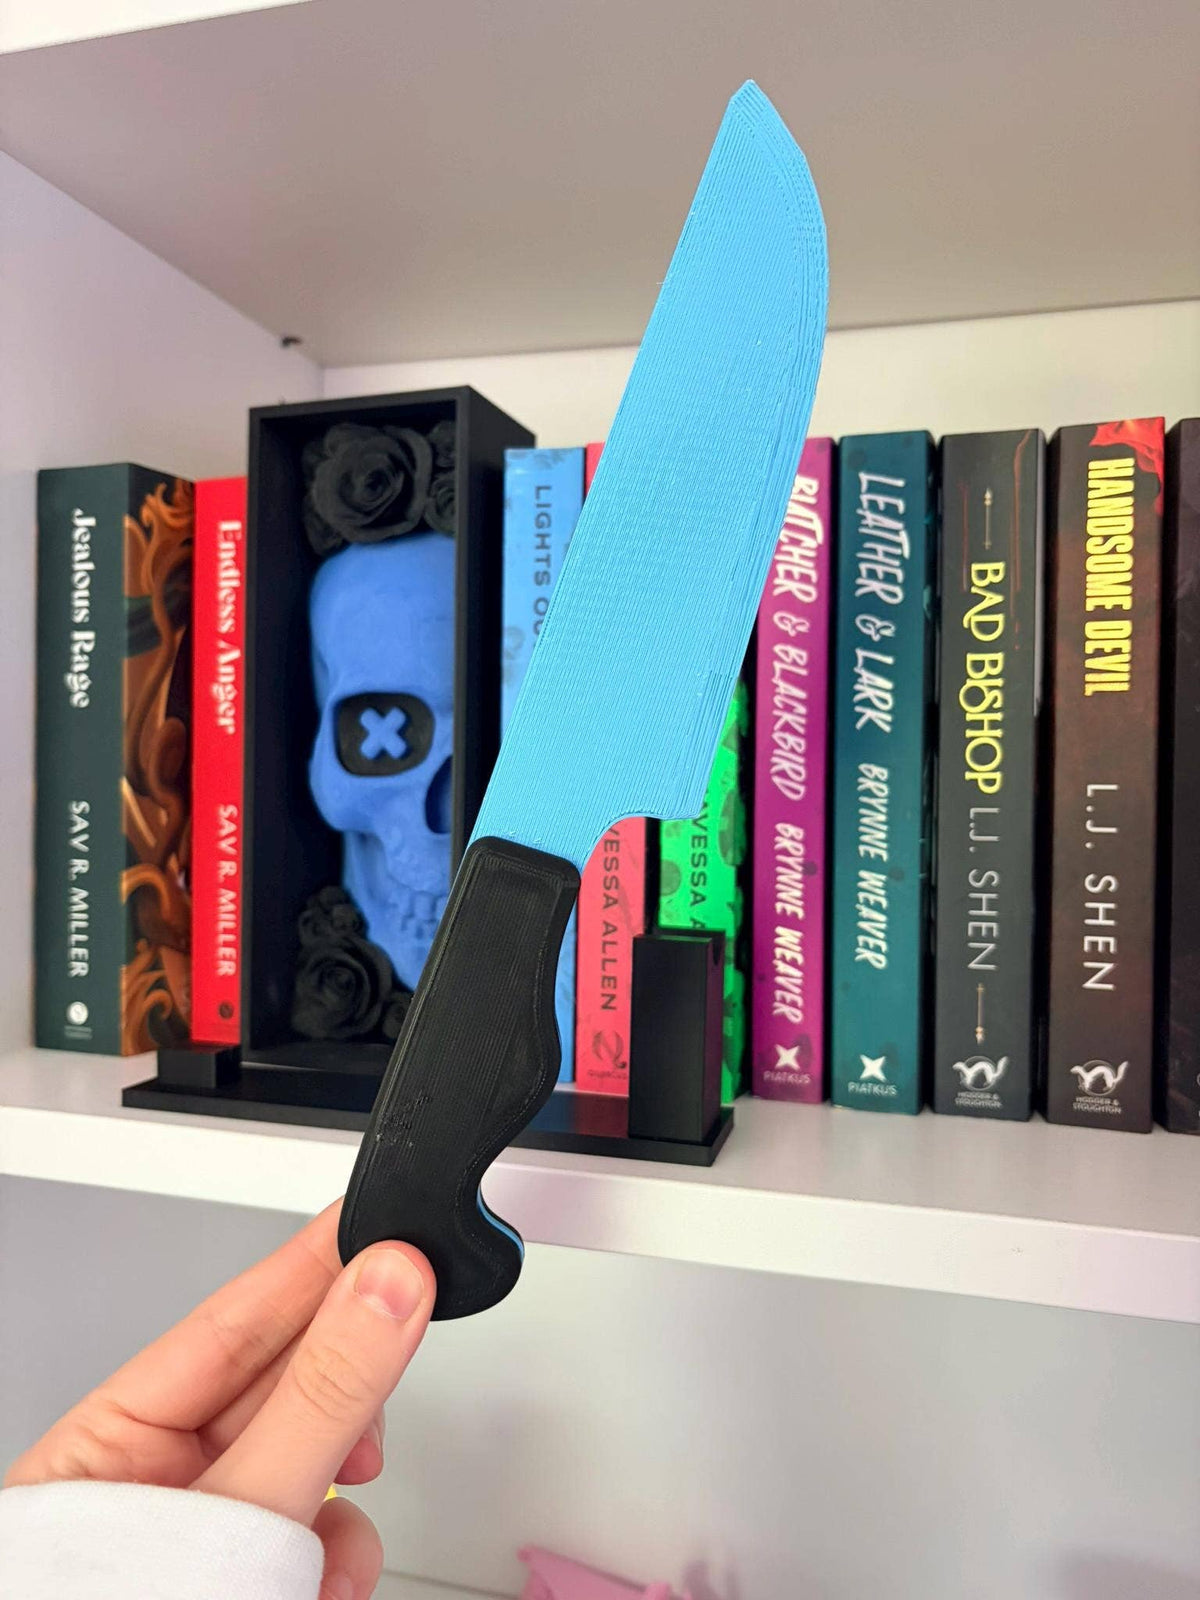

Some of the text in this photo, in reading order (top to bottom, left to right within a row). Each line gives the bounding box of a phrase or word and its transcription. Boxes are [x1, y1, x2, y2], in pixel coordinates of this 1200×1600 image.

[64, 507, 97, 709] Jealous Rage
[212, 520, 243, 735] Endless Anger
[533, 485, 552, 648] LIGHTS OU
[770, 473, 825, 802] BUTCHER & BLACKBIRD
[853, 471, 911, 734] LEATHER & LARK
[1084, 457, 1135, 697] HANDSOME DEVIL
[958, 561, 1006, 795] BAD BISHOP
[67, 800, 91, 979] SAV R. MILLER
[216, 804, 239, 977] SAV R. MILLER
[601, 920, 618, 1011] ALLEN
[773, 822, 806, 1024] BRYNNE WEAVER
[855, 762, 889, 970] BRYNNE WEAVER
[967, 807, 1000, 971] L.J. SHEN
[1082, 783, 1119, 991] L.J. SHEN
[847, 1081, 898, 1096] PIATKUS
